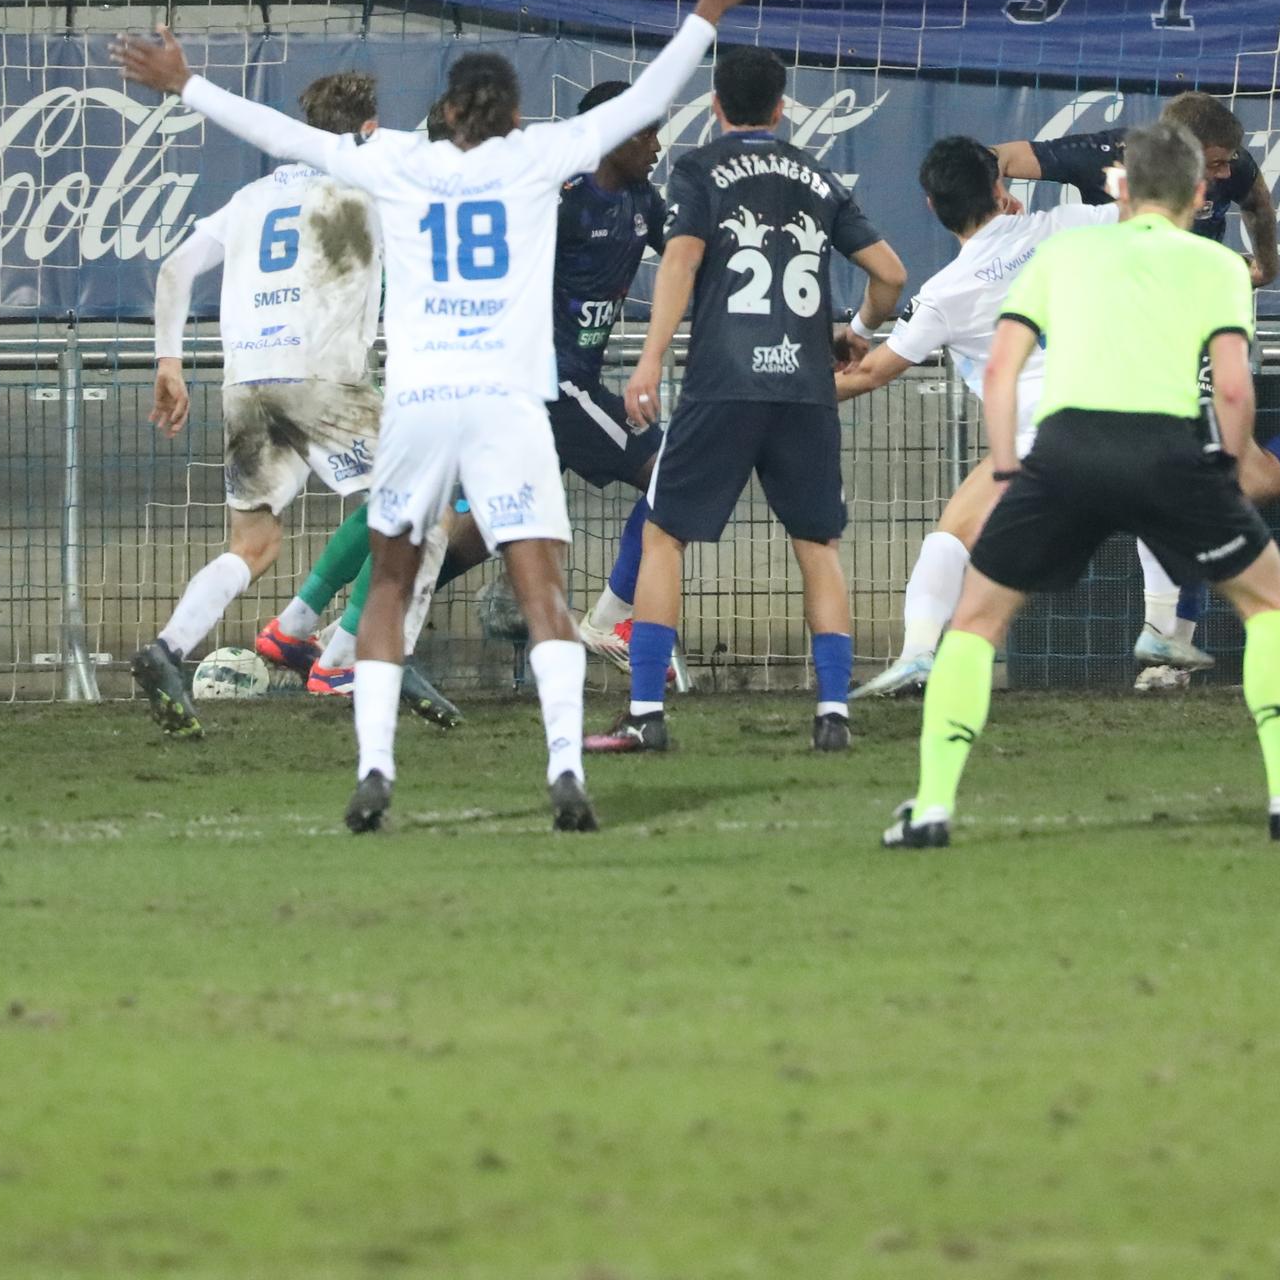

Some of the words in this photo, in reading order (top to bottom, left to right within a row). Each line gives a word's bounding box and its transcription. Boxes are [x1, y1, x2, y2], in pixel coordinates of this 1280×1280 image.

[712, 156, 831, 199] ORATMANGOEN
[258, 204, 302, 274] 6
[419, 199, 510, 283] 18
[254, 286, 301, 309] SMETS
[726, 248, 821, 318] 26
[413, 338, 506, 353] ARGLASS
[752, 344, 797, 365] STAR
[752, 362, 796, 374] CASINO
